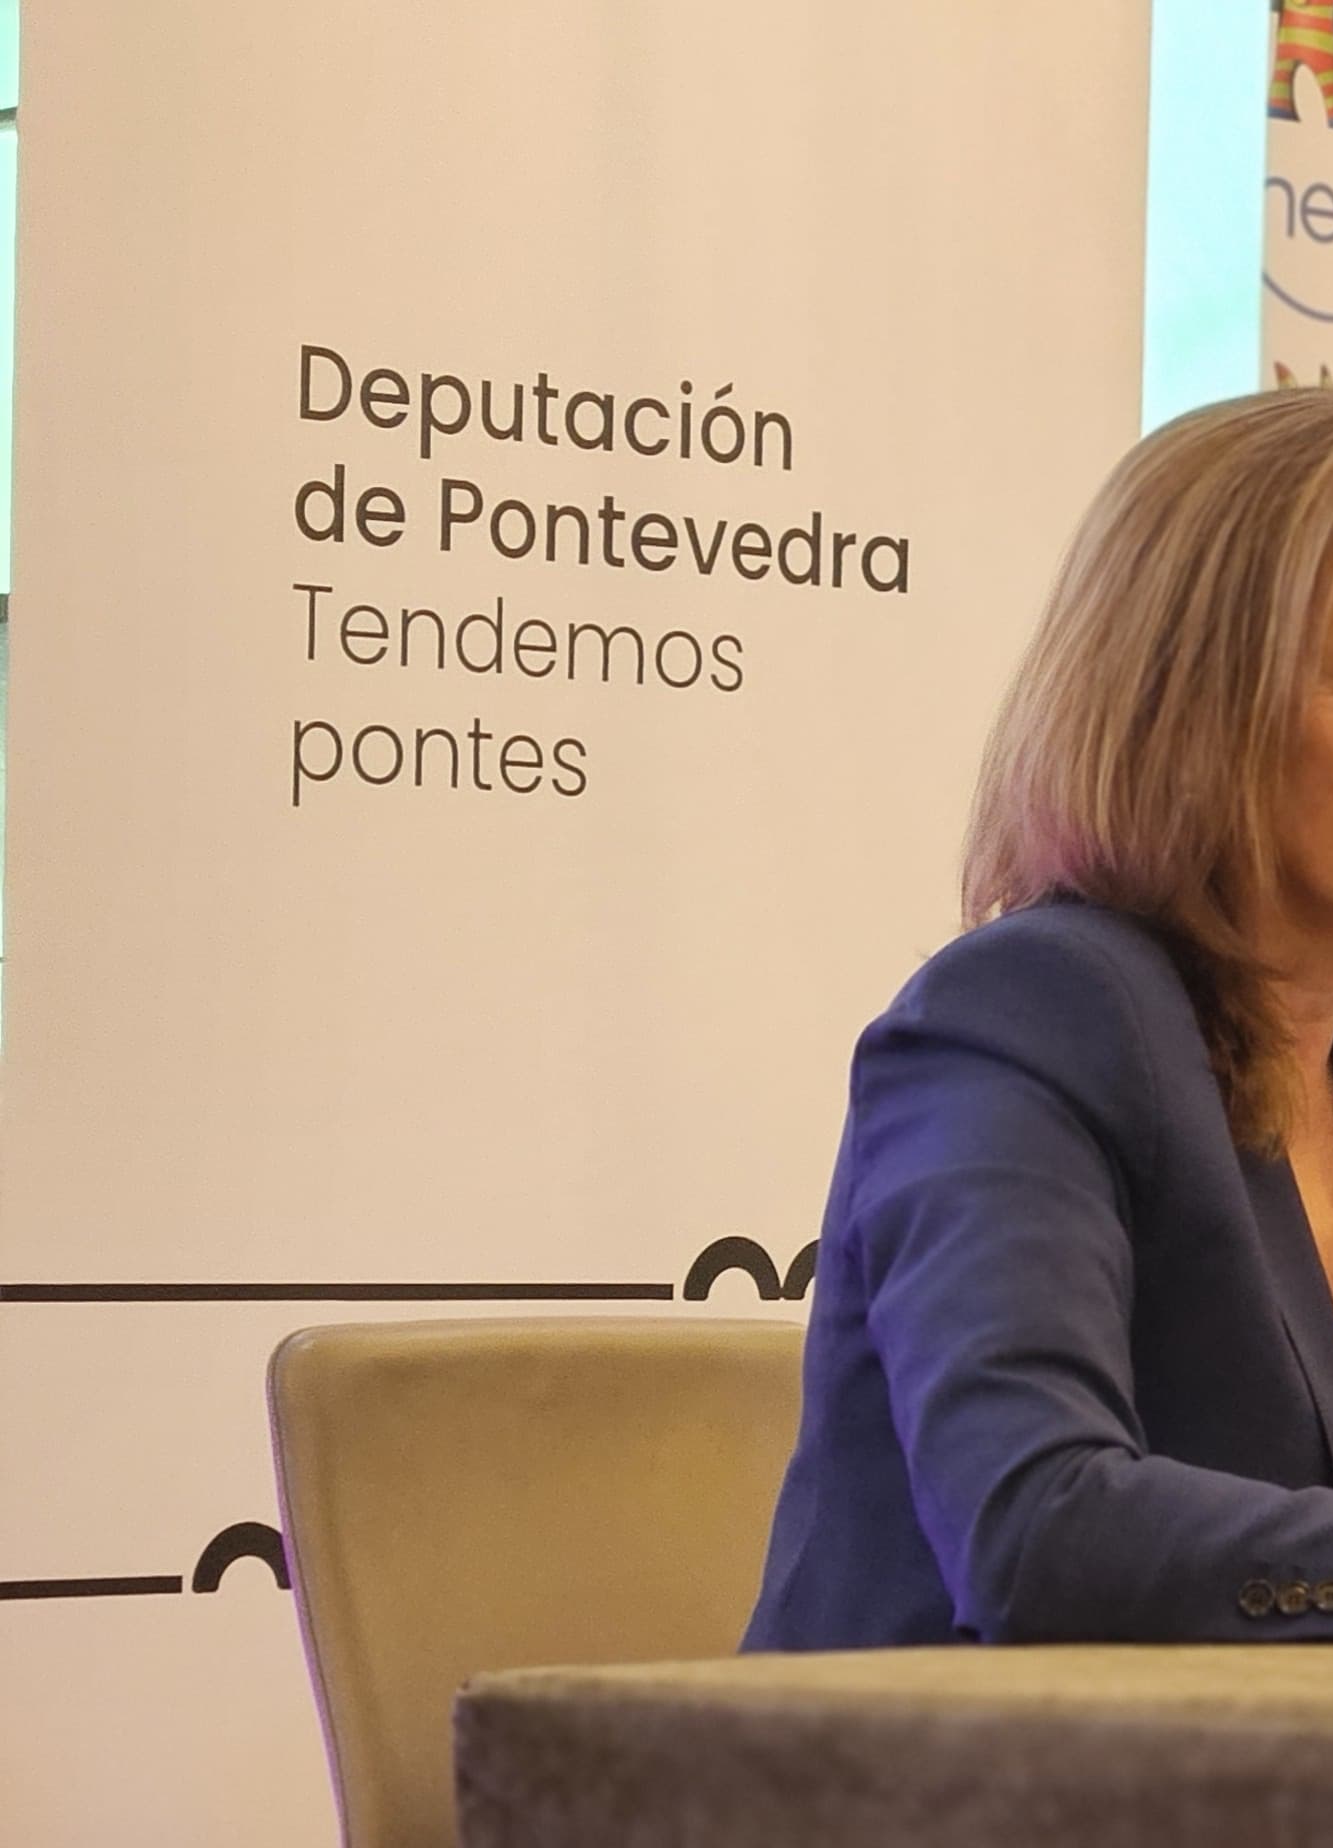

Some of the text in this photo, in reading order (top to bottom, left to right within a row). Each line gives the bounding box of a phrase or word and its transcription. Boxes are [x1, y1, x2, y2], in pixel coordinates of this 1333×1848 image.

[299, 344, 793, 471] Deputación
[294, 463, 909, 594] de Pontevedra
[292, 583, 744, 692] Tendemos
[292, 717, 587, 807] pontes
